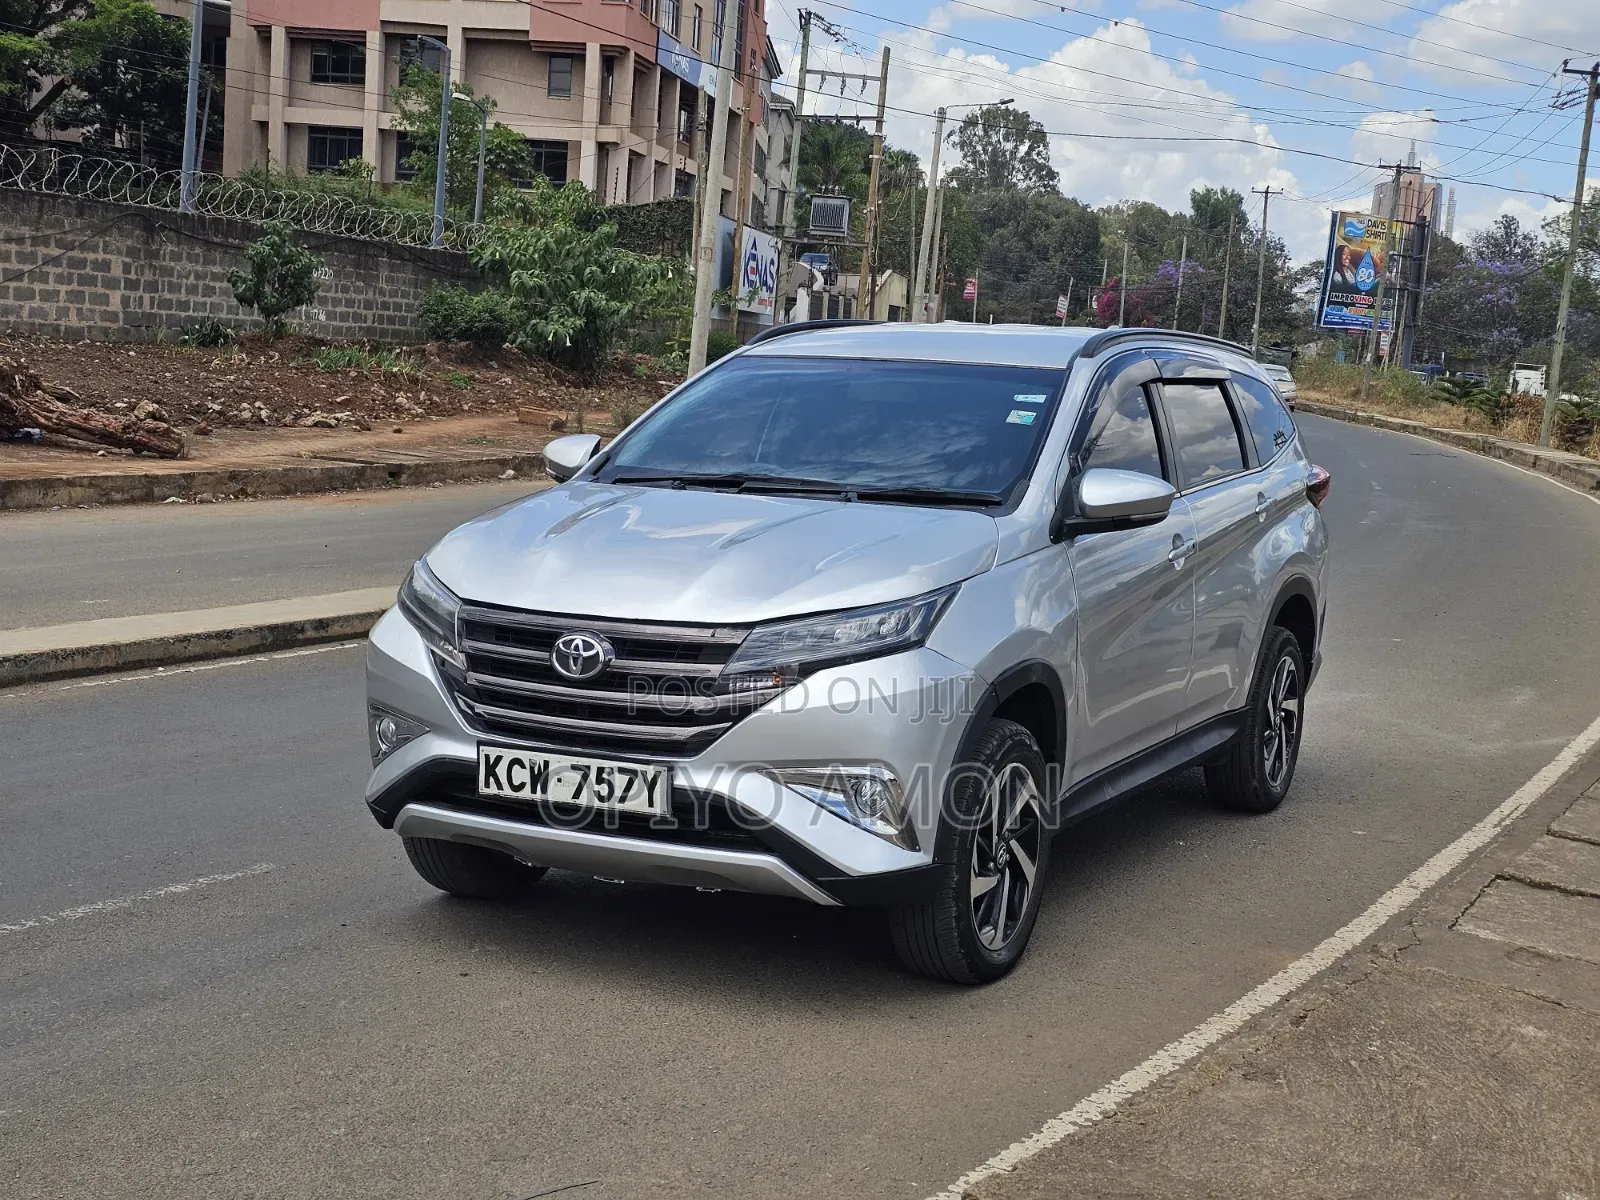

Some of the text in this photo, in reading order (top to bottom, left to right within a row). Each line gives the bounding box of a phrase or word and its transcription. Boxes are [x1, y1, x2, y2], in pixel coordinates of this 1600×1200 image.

[1367, 218, 1387, 231] DAVIS
[1357, 267, 1375, 284] 80
[1330, 292, 1374, 305] IMPROVING
[483, 753, 662, 808] KCW 757Y
